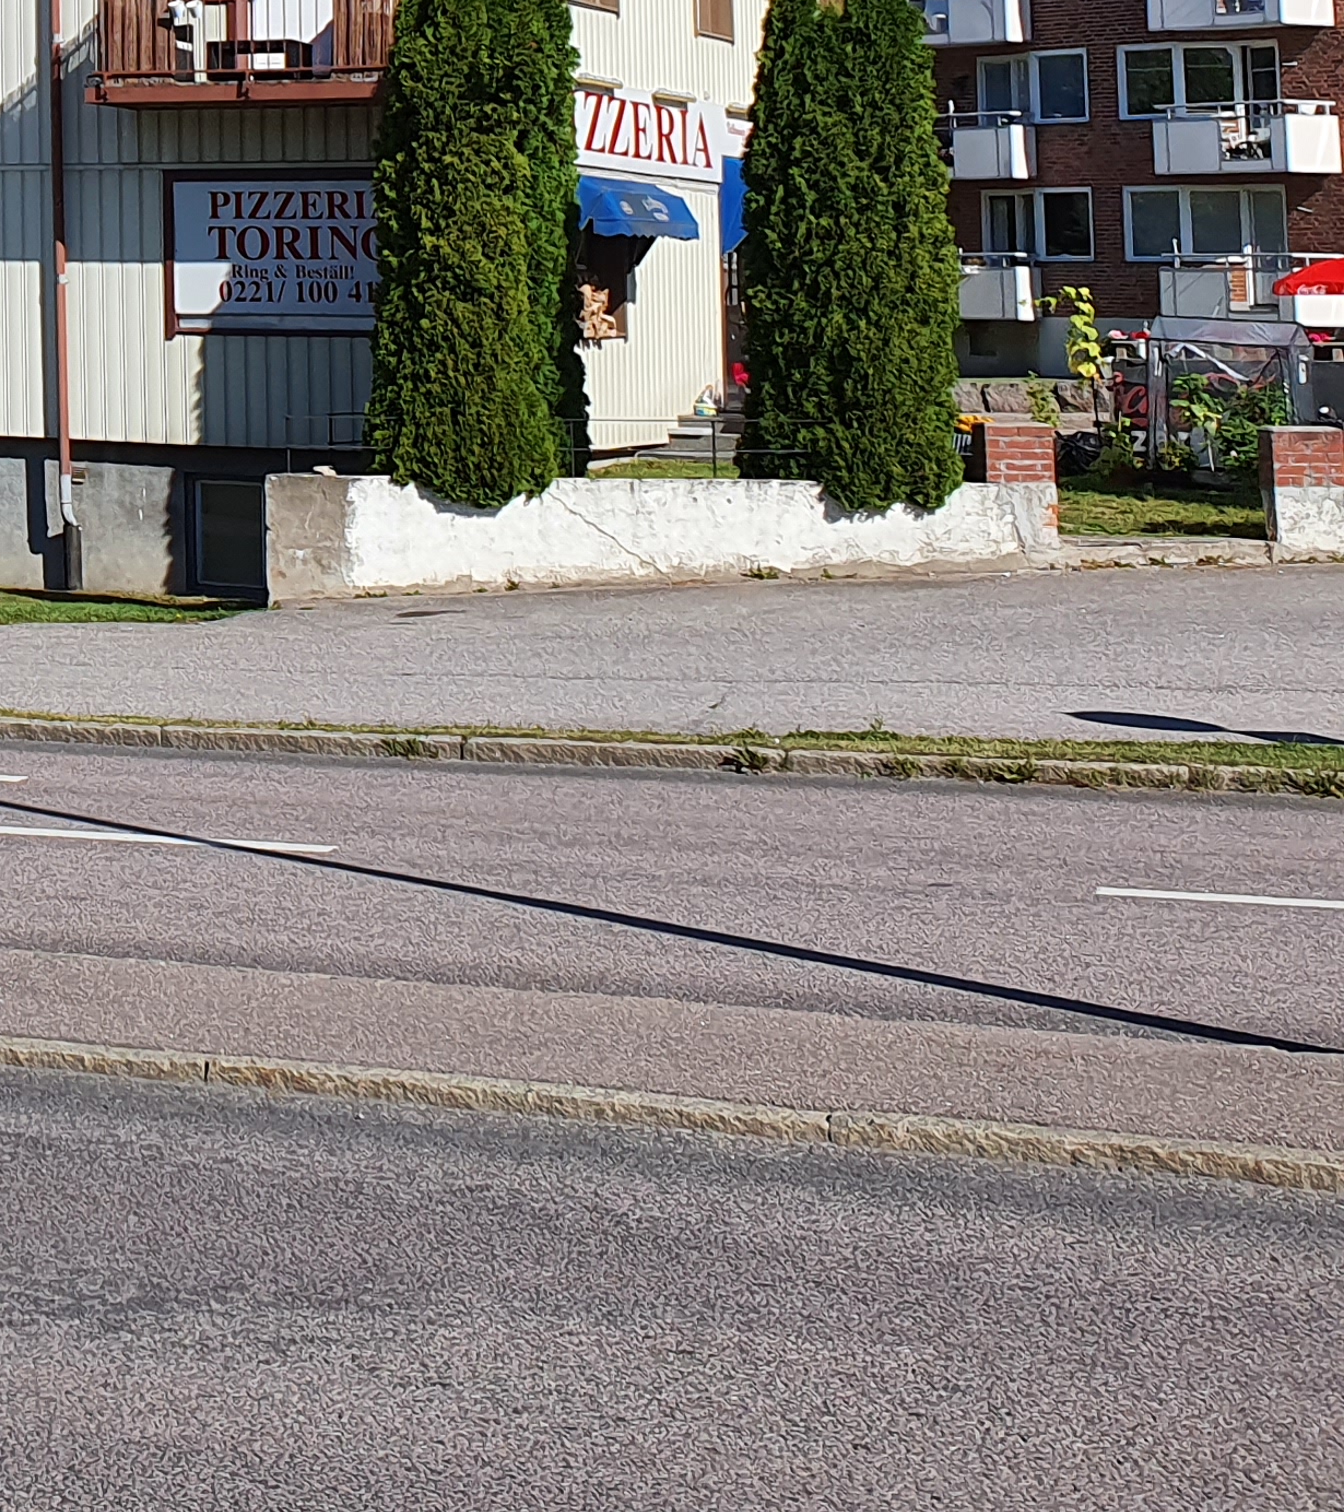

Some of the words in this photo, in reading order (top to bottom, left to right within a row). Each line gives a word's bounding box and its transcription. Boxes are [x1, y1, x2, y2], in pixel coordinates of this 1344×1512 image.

[583, 91, 714, 169] ZZERIA
[207, 190, 379, 220] PIZZERI
[232, 264, 269, 282] Ring
[274, 265, 287, 279] &
[295, 263, 355, 280] Beställ!
[219, 280, 286, 303] 0221/
[296, 280, 338, 303] 100
